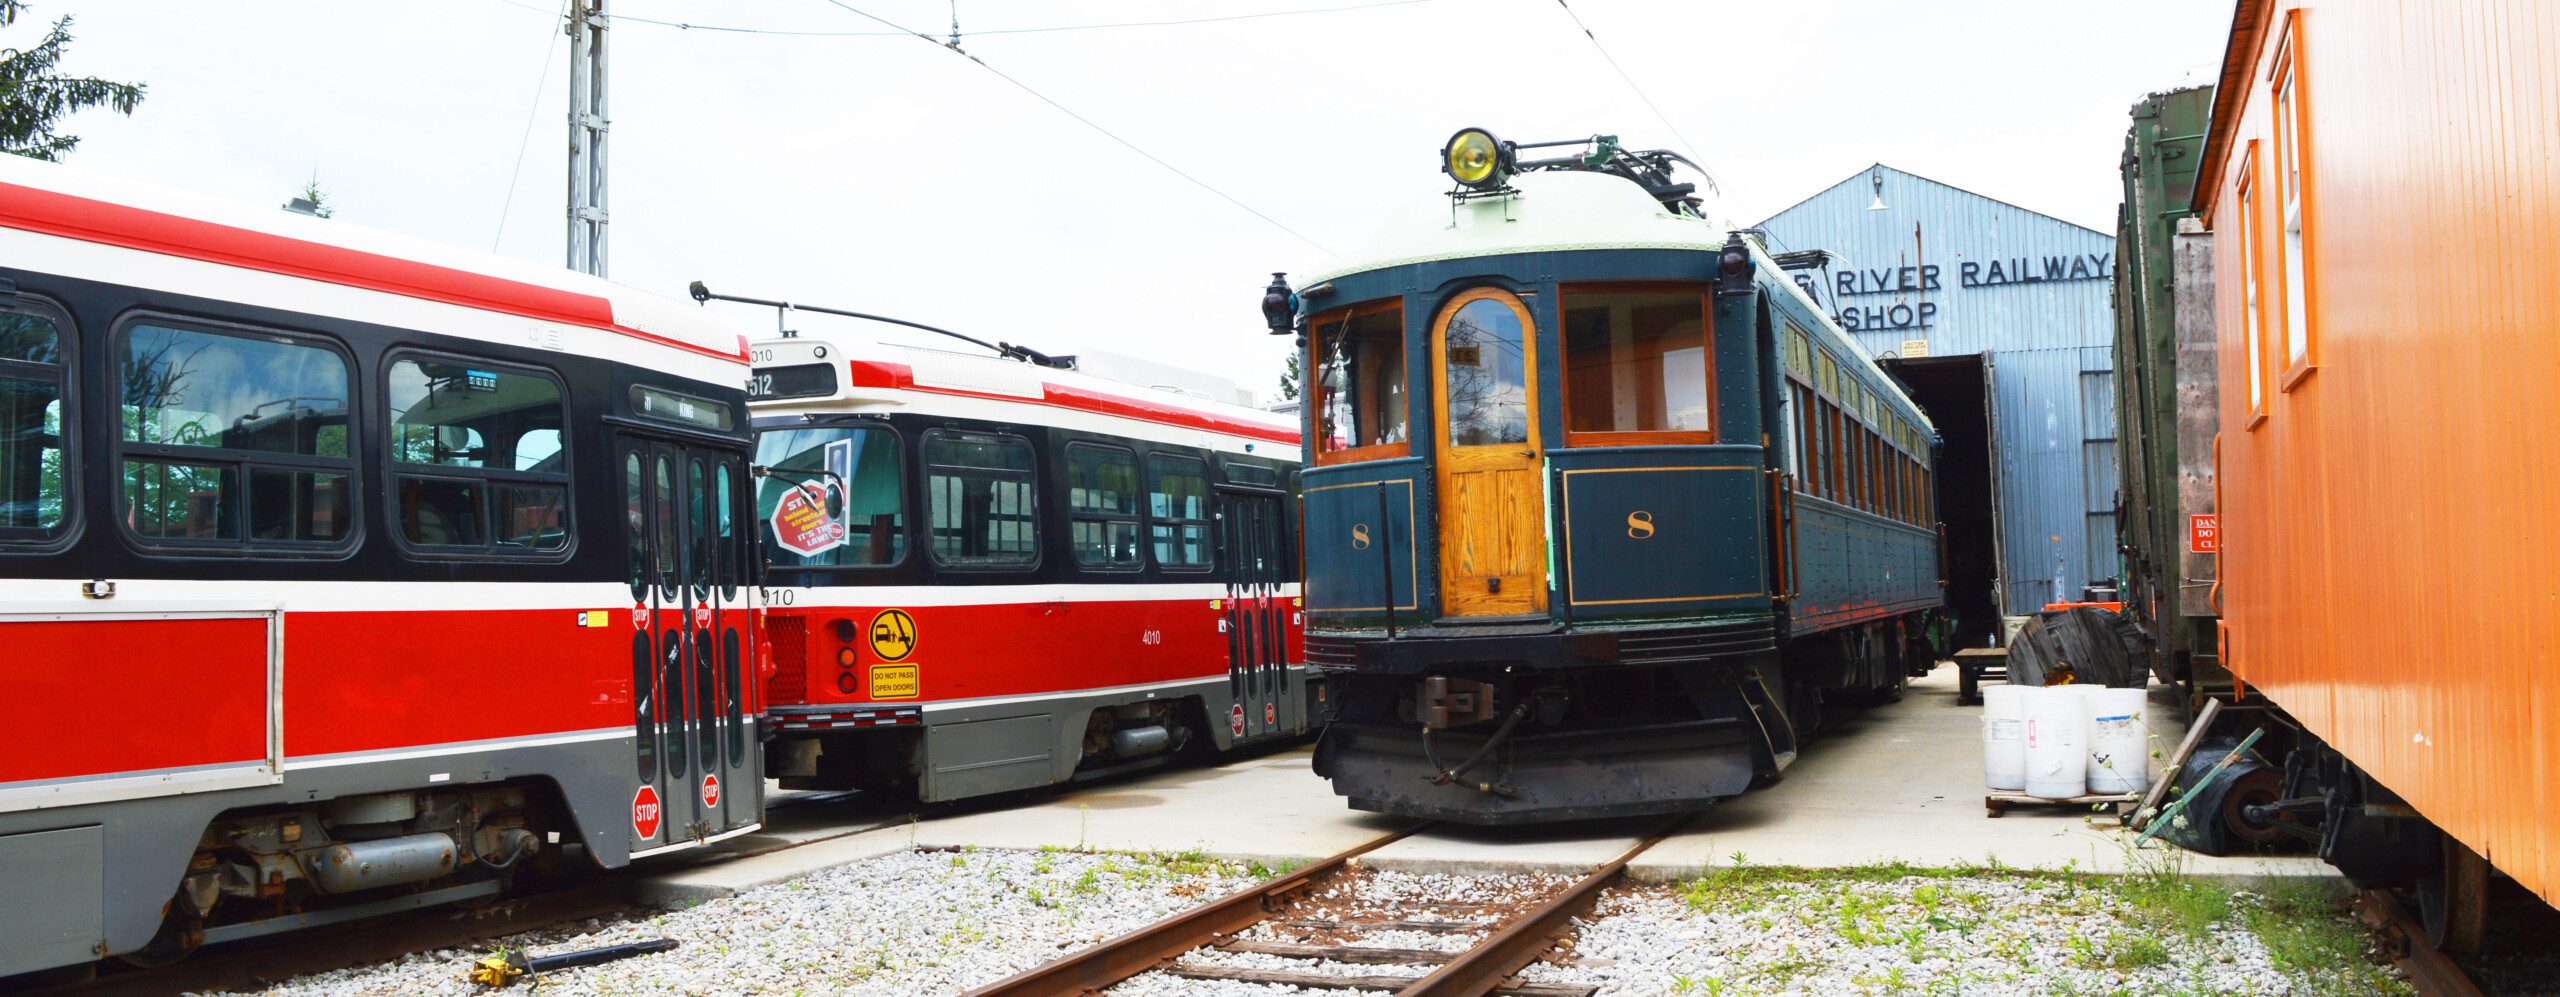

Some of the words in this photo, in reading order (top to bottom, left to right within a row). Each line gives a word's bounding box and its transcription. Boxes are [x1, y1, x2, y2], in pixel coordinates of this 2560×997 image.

[1837, 264, 1941, 296] RIVER
[1961, 252, 2110, 288] RAILWAY
[1842, 302, 1937, 331] SHOP
[752, 349, 773, 362] 010
[750, 374, 773, 396] 512
[1628, 510, 1654, 539] 8
[2196, 518, 2216, 527] DAN
[1352, 523, 1369, 550] 8
[2198, 529, 2213, 538] DO
[2201, 540, 2215, 548] CL
[764, 589, 794, 605] 10
[634, 609, 647, 621] STOP
[697, 609, 709, 620] STOP
[1143, 629, 1160, 645] 4010
[899, 671, 914, 679] PASS
[706, 785, 717, 798] STOP
[636, 803, 657, 822] STOP
